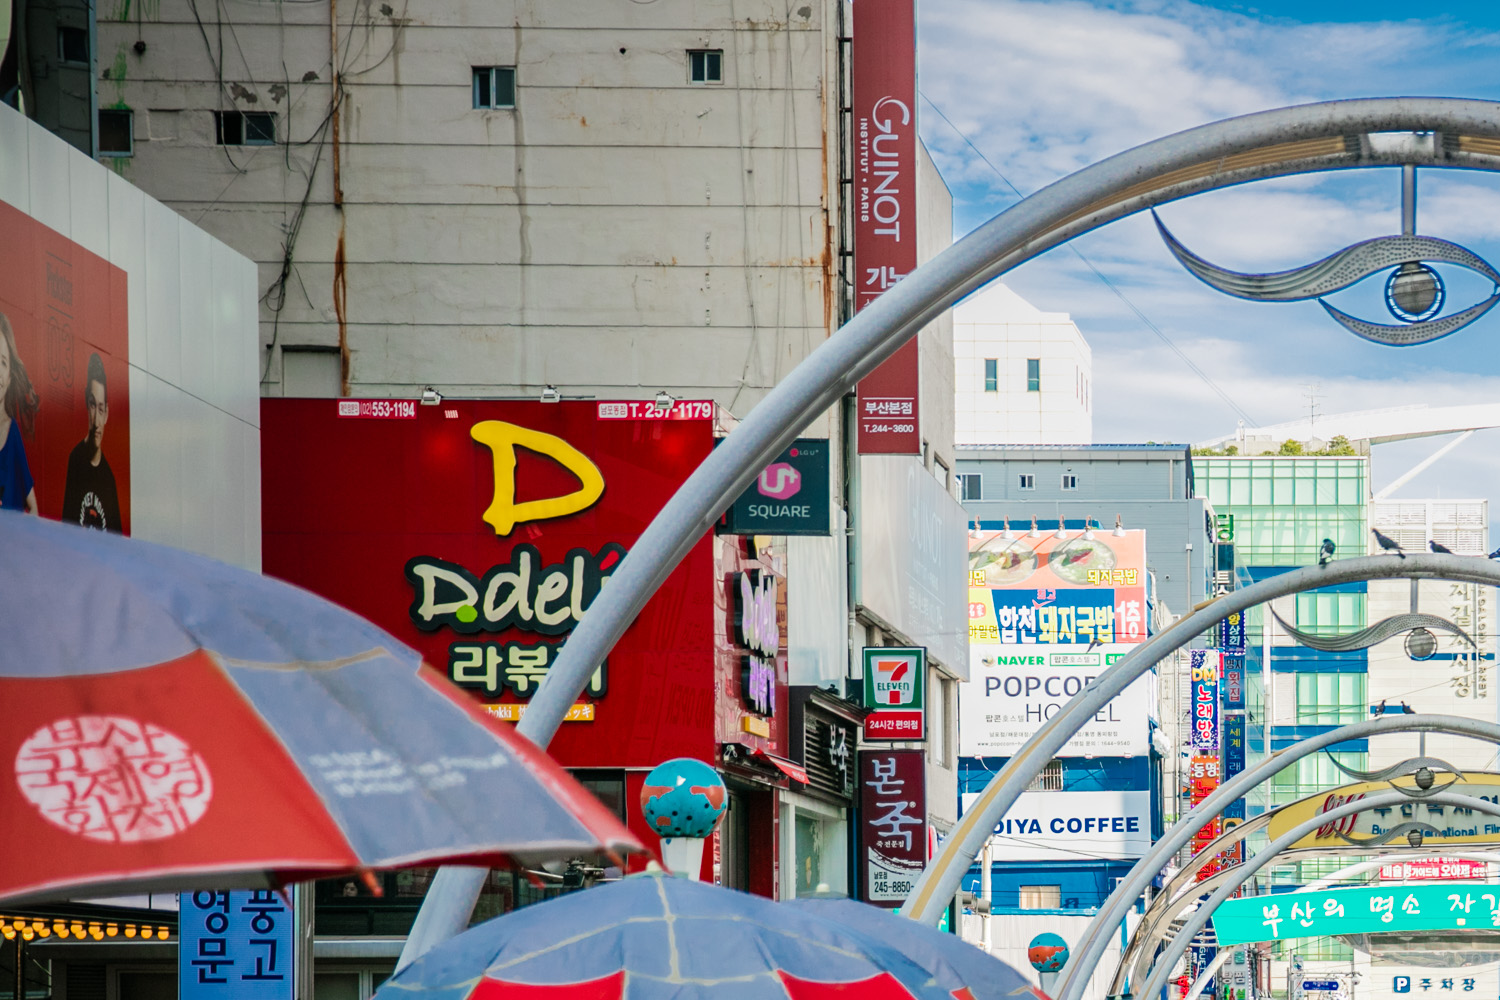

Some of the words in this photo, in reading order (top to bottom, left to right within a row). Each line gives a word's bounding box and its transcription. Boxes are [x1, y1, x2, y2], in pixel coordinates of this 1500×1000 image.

[860, 117, 868, 173] INSTITUT
[872, 96, 910, 242] GUINOT
[860, 187, 868, 223] PARIS
[864, 401, 913, 415] 부산본점
[863, 424, 914, 434] T.244-3600
[747, 504, 811, 519] SQUARE
[1087, 569, 1138, 586] 돼지국밥
[999, 605, 1036, 644] 합천
[1038, 605, 1115, 644] 돼지국밥
[1116, 600, 1141, 638] 1층
[997, 655, 1045, 666] NAVER
[1191, 667, 1216, 682] DM
[985, 676, 1121, 697] POPCO
[1026, 703, 1121, 722] HOEL
[1197, 685, 1214, 739] 노래방
[869, 719, 895, 730] 24시간
[895, 719, 919, 730] 편의점
[1193, 761, 1217, 778] 동명
[866, 757, 923, 851] 본죽
[991, 818, 1043, 835] DIYA
[1049, 816, 1140, 834] COFFEE
[1262, 897, 1345, 938] 부산의
[1370, 893, 1421, 924] 명소
[191, 938, 284, 983] 문고
[1418, 977, 1476, 992] 주차장
